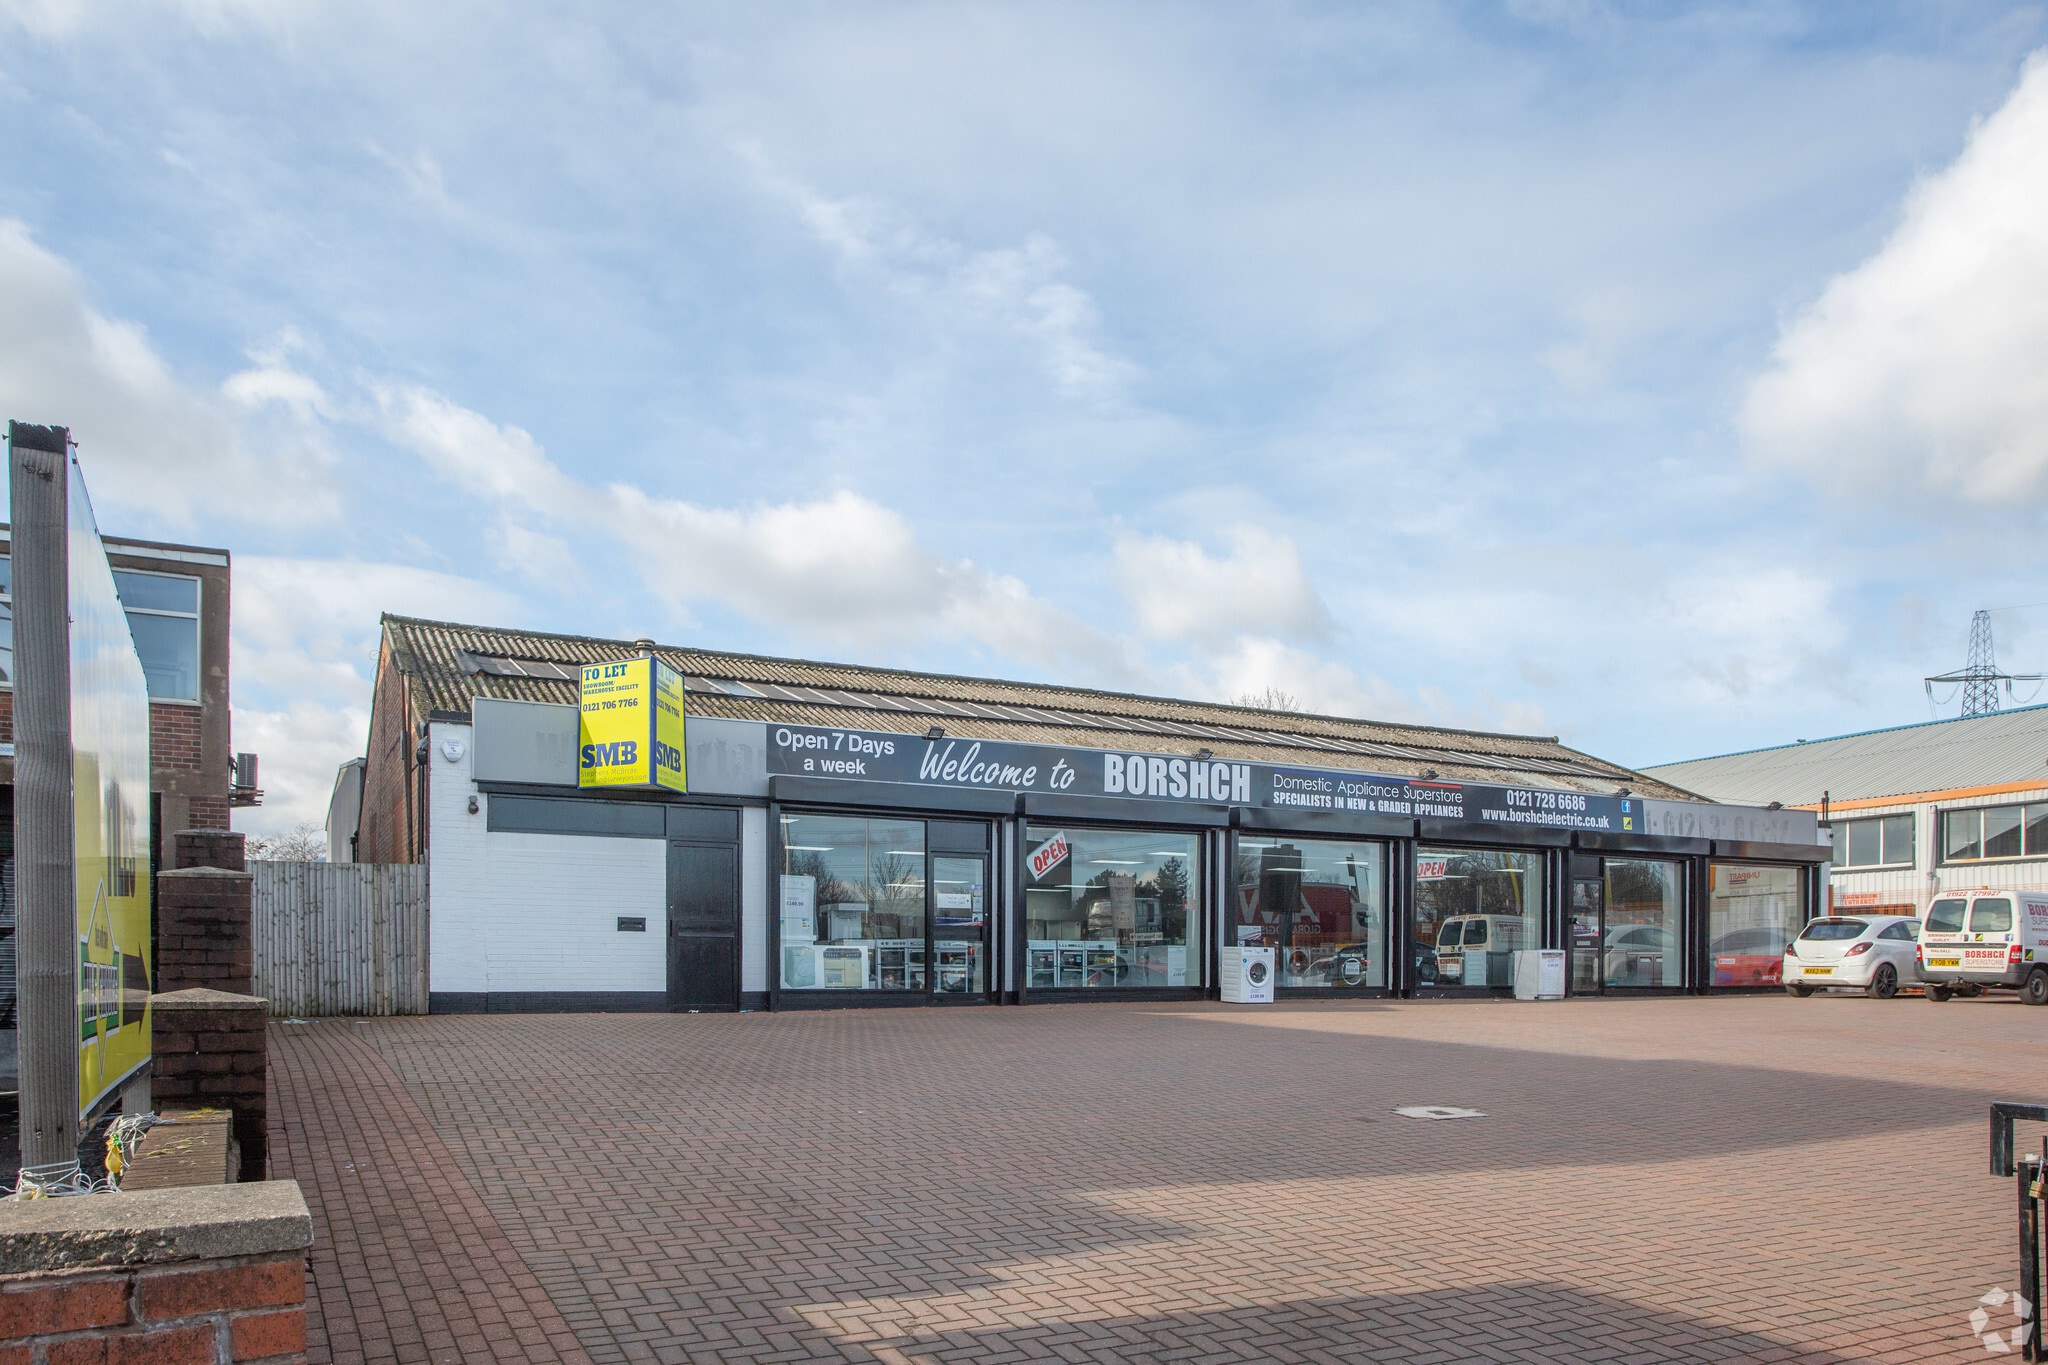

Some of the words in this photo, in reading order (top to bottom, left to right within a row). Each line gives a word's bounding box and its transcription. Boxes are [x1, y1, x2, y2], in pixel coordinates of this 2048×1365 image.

[584, 668, 600, 681] TO
[604, 664, 628, 679] LET
[583, 687, 615, 695] WAREHOUSE
[616, 683, 639, 692] FACILITY
[583, 703, 600, 712] 0121
[602, 700, 617, 710] 706
[619, 698, 638, 708] 7766
[775, 728, 829, 752] Open
[832, 732, 845, 751] 7
[848, 734, 895, 758] Days
[581, 740, 638, 769] SMB
[656, 740, 682, 773] SMB
[803, 757, 814, 771] a
[820, 758, 866, 775] week
[919, 741, 1037, 787] Welcome
[1050, 757, 1076, 789] to
[1103, 753, 1251, 802] BORSHCH
[1273, 774, 1333, 792] Domestic
[1337, 780, 1399, 797] Appliance
[1403, 786, 1463, 803] Superstore
[1273, 791, 1332, 808] SPECIALISTS
[1334, 796, 1344, 809] IN
[1347, 798, 1367, 811] NEW
[1369, 800, 1376, 811] &
[1378, 800, 1411, 814] GRADED
[1414, 804, 1464, 818] APPLIANCES
[1506, 789, 1532, 807] 0121
[1534, 792, 1556, 809] 728
[1558, 794, 1586, 811] 6686
[1481, 808, 1610, 828] www.borshchelectric.co.uk
[1033, 837, 1067, 872] OPEN
[1417, 861, 1445, 876] OPEN
[1964, 950, 2005, 959] BORSHCH
